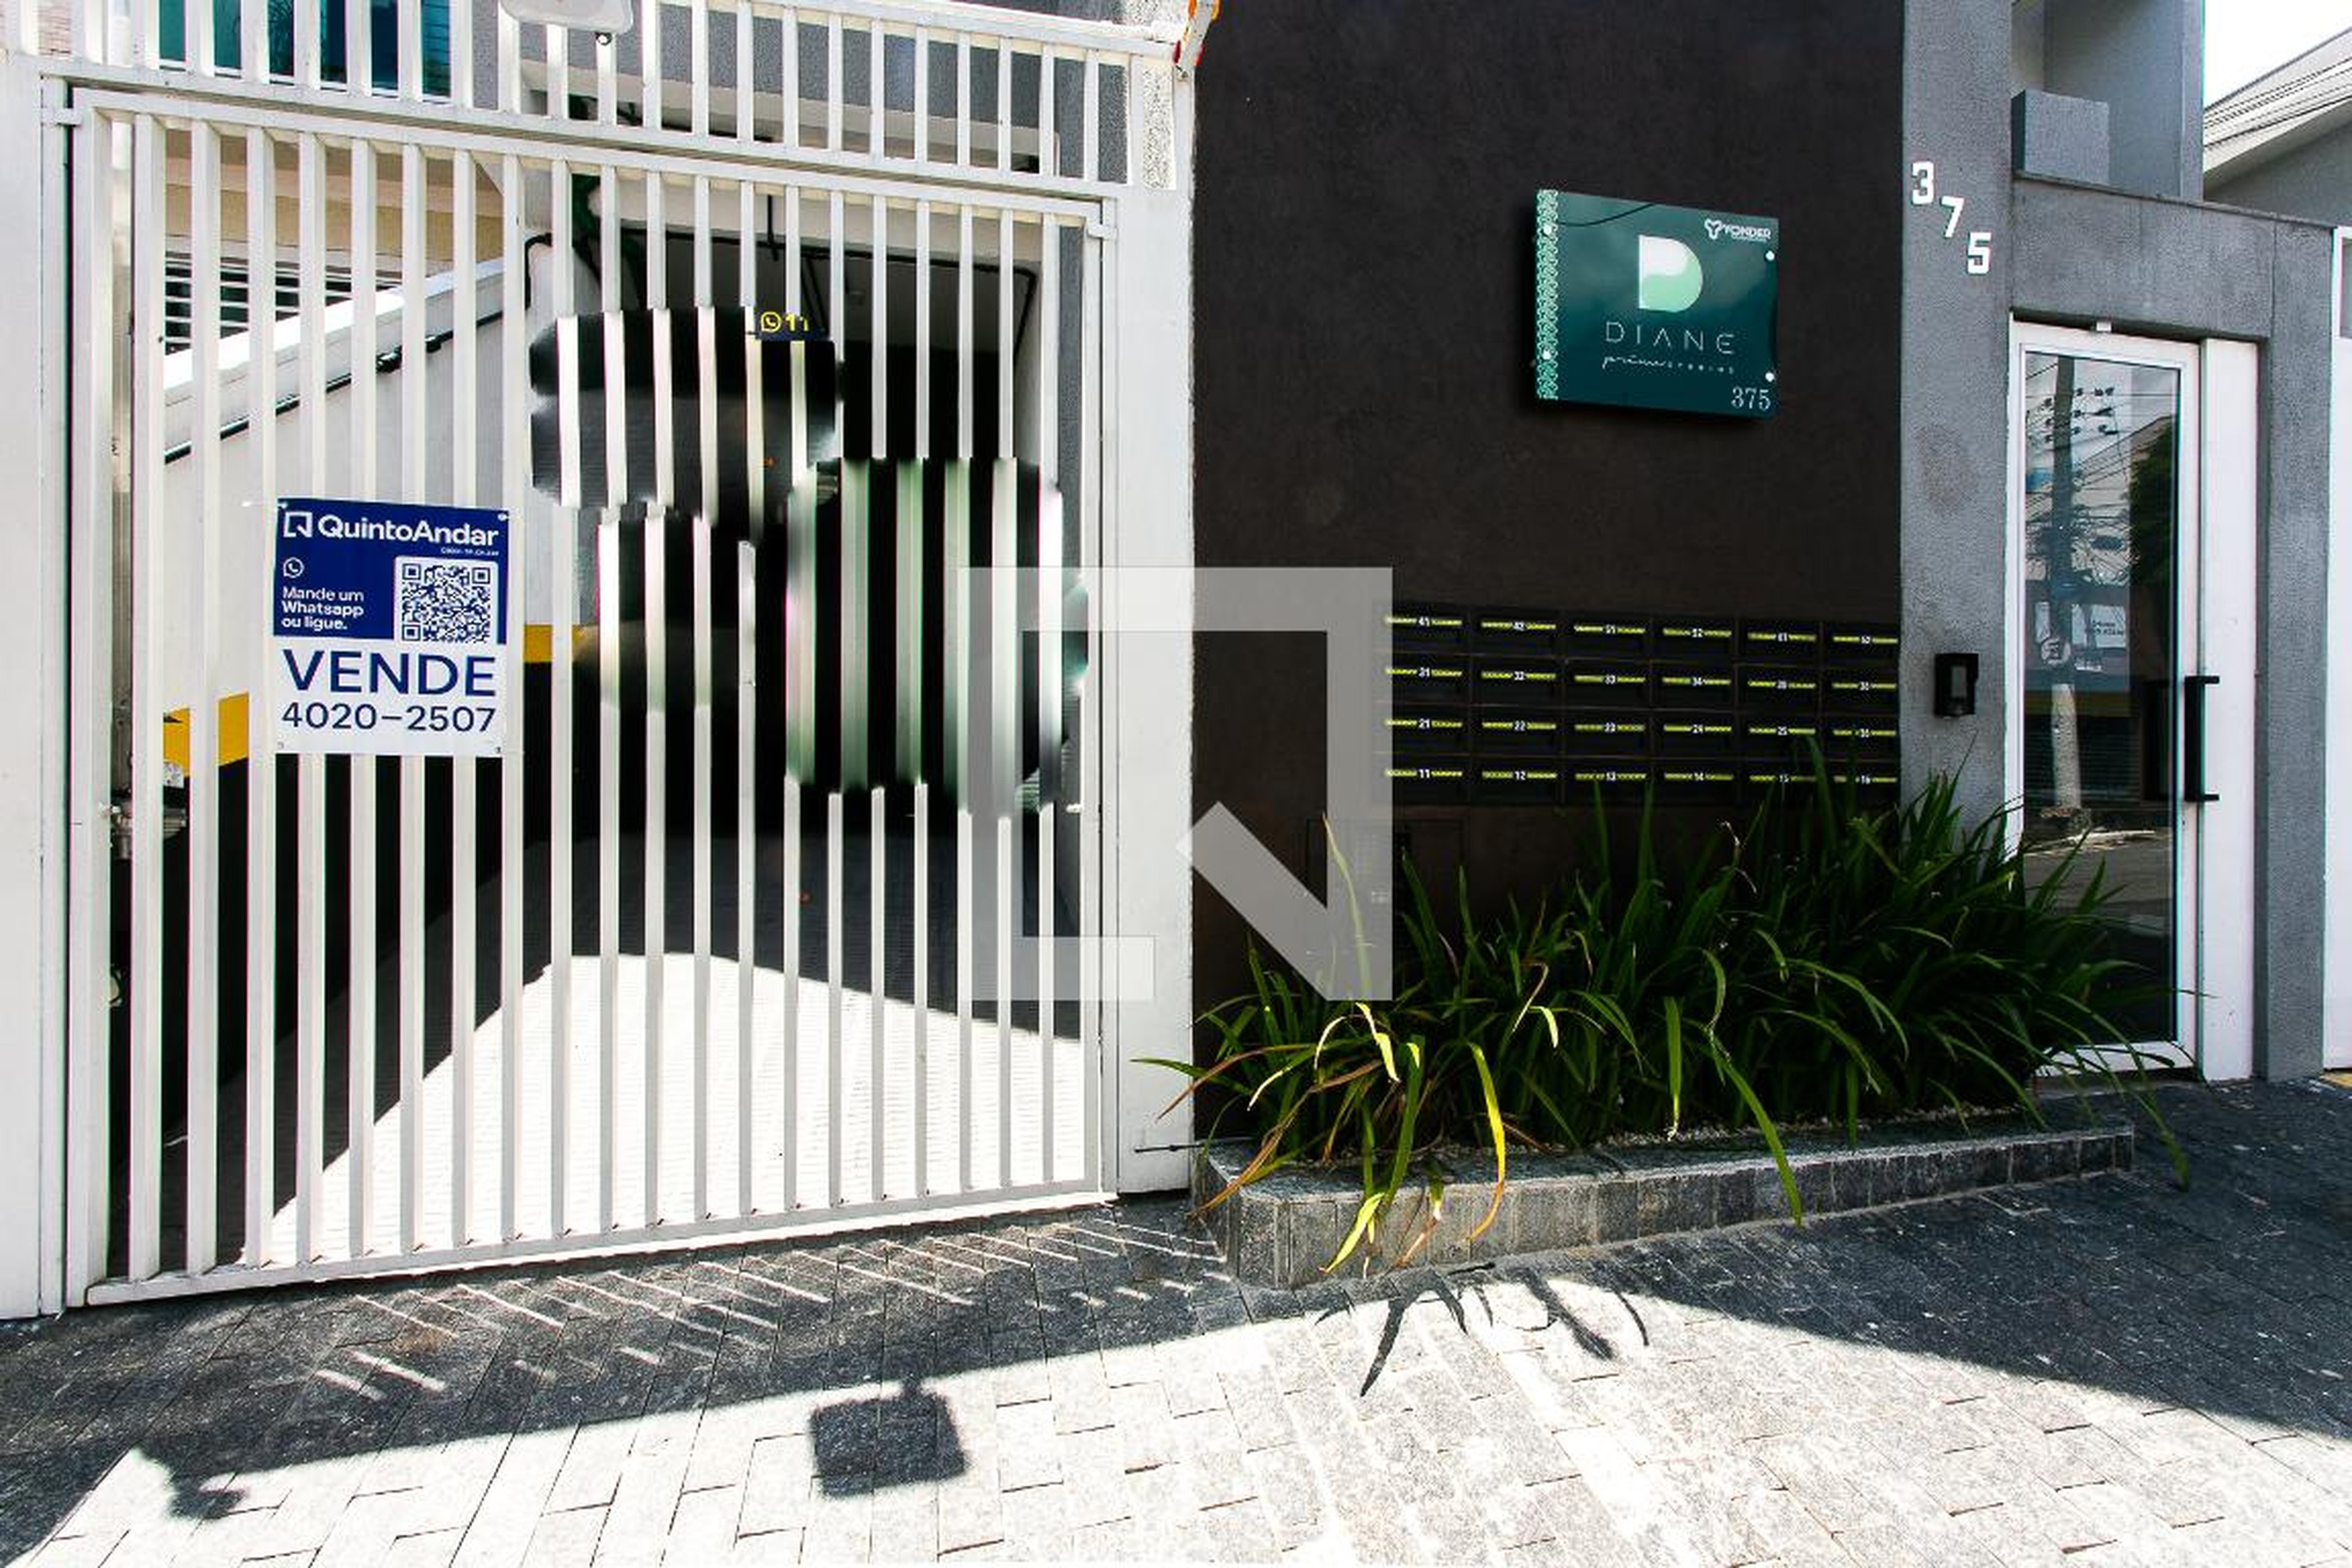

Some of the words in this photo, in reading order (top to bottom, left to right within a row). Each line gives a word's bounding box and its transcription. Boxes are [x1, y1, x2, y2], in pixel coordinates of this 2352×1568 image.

[1912, 161, 1992, 274] 375
[1605, 321, 1735, 355] DIANE
[1731, 386, 1771, 412] 375
[317, 514, 500, 546] QuintoAndar
[282, 586, 336, 601] Mande
[338, 592, 364, 602] um
[282, 600, 365, 617] Whatsapp
[281, 618, 302, 629] ou
[304, 614, 349, 632] ligue.
[283, 649, 497, 698] VENDE
[281, 701, 497, 733] 4020-2507
[1419, 769, 1431, 779] 11
[1515, 771, 1526, 781] 12
